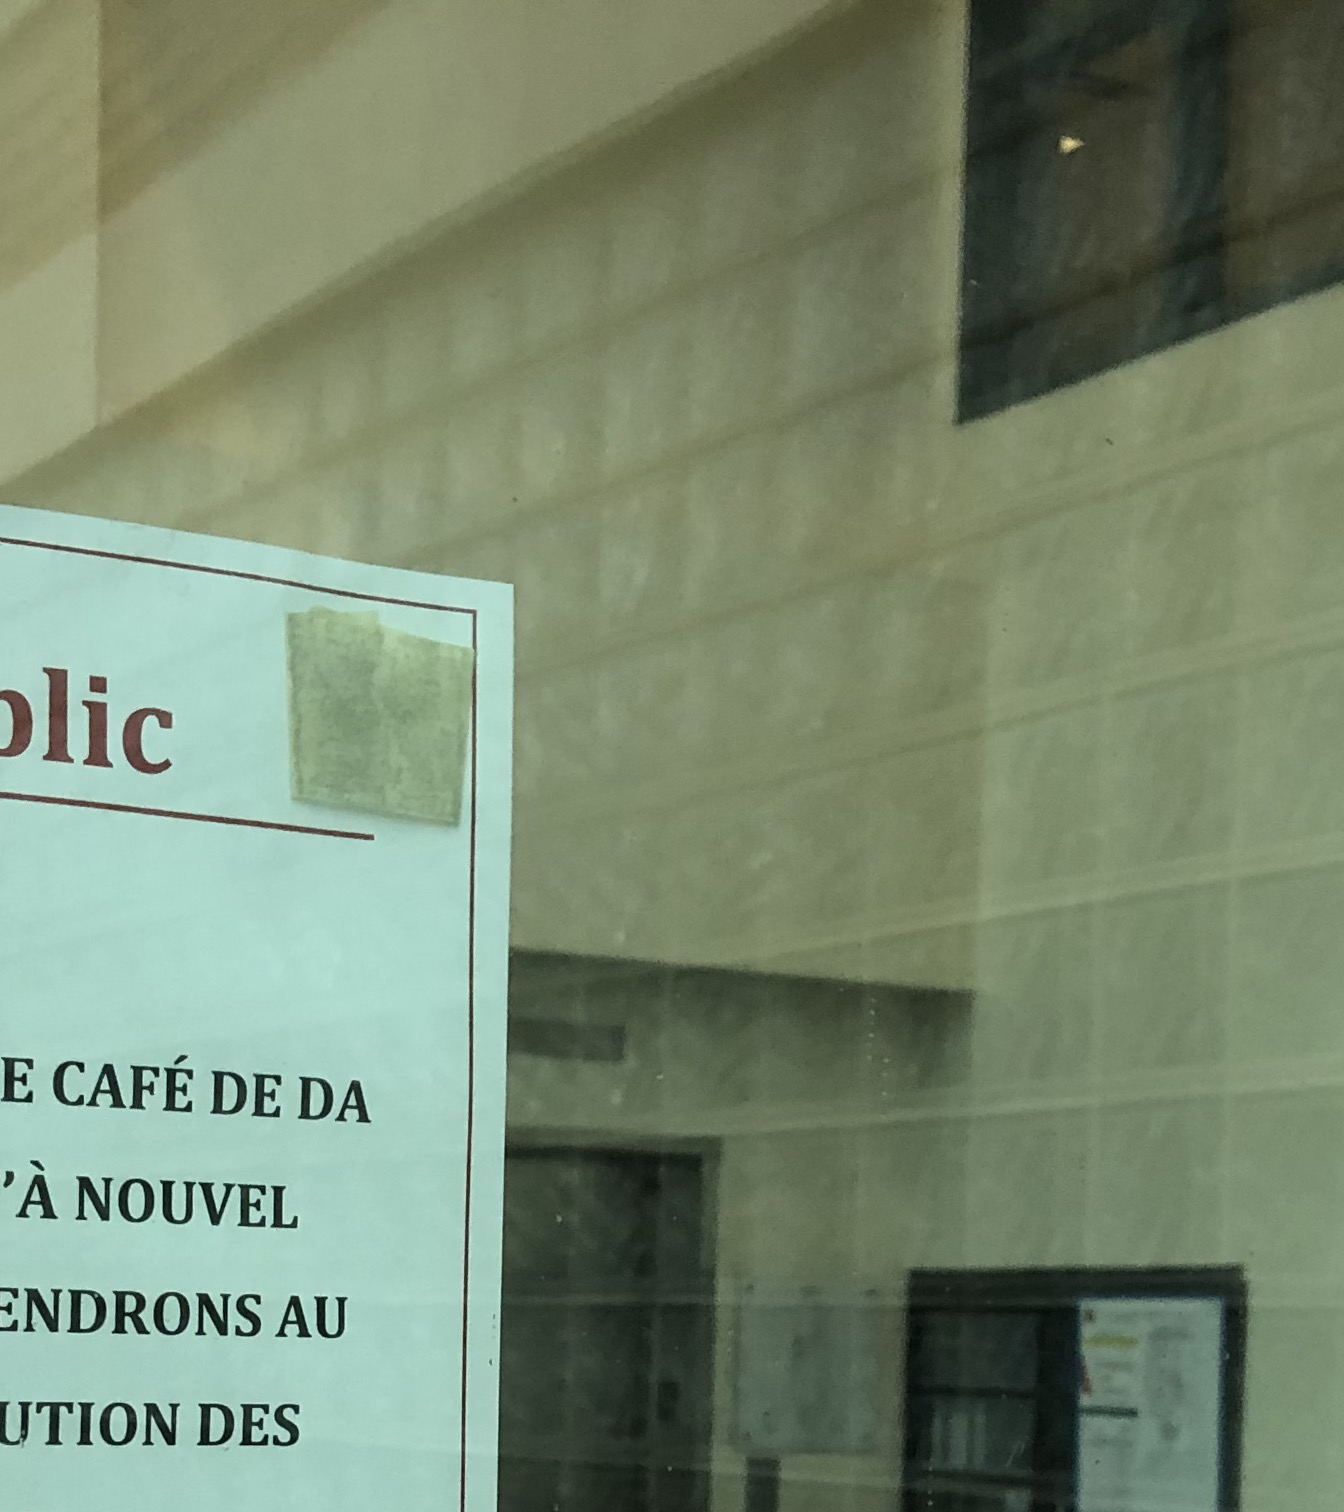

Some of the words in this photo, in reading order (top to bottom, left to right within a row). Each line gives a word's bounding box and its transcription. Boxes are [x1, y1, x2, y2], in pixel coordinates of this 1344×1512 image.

[53, 1055, 194, 1113] CAFÉ
[210, 1070, 282, 1118] DE
[298, 1076, 372, 1123] DA
[75, 1176, 299, 1229] NOUVEL
[275, 1296, 348, 1338] AU
[197, 1403, 301, 1447] DES
